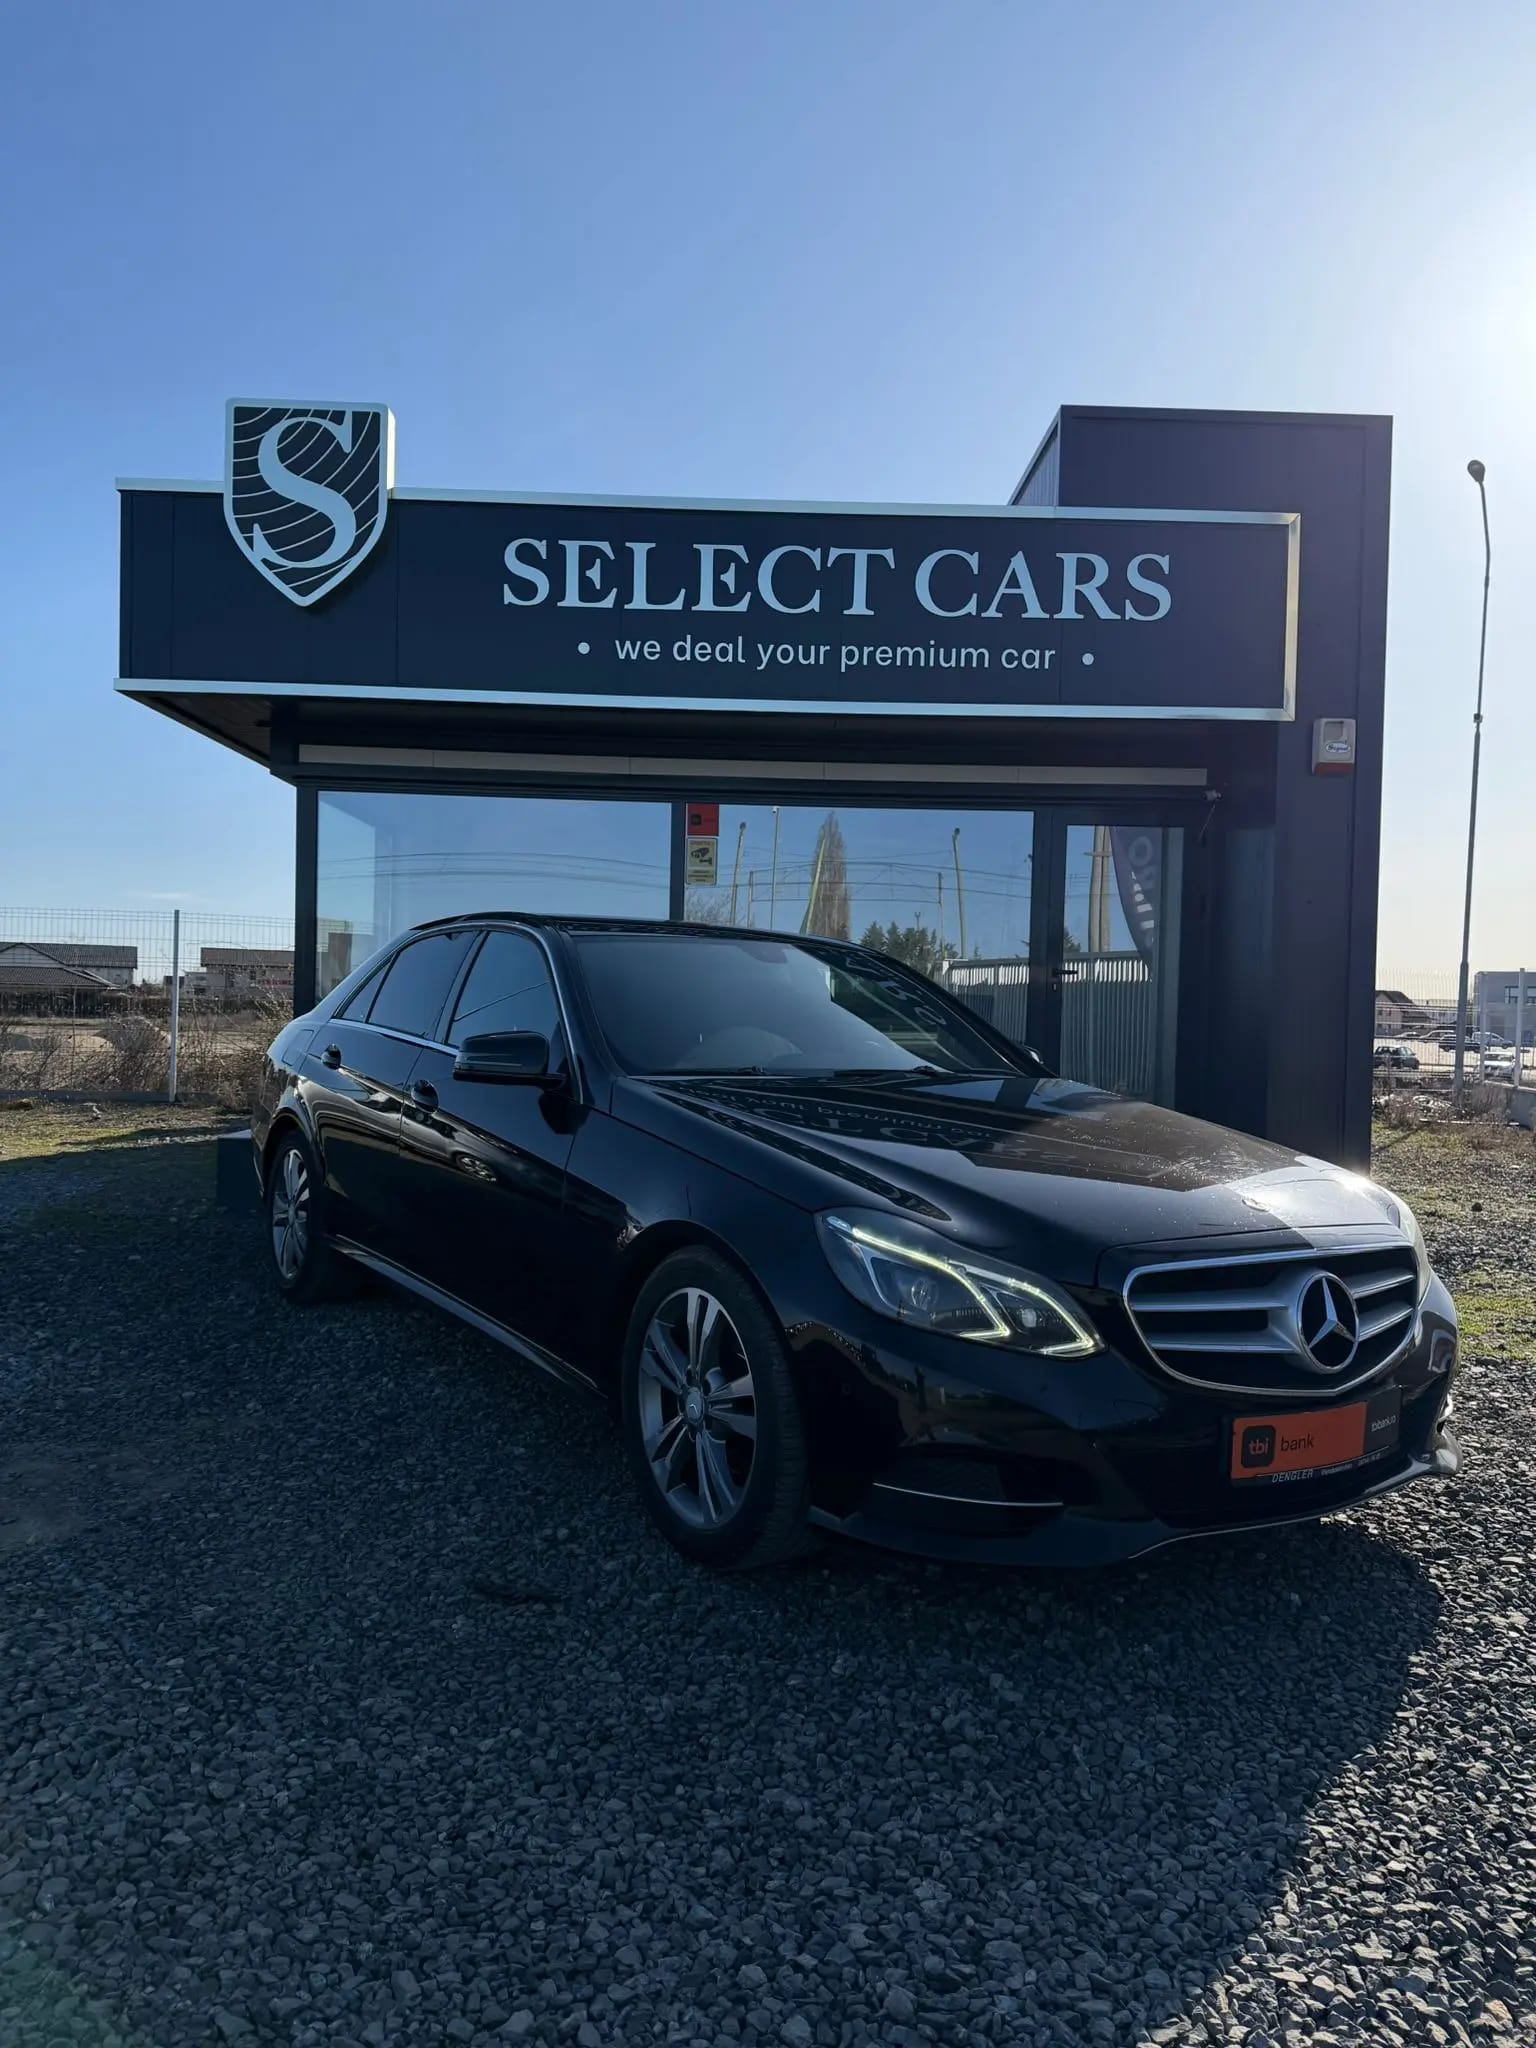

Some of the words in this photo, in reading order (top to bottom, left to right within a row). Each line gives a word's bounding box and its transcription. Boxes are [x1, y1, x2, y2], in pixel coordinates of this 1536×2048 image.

[252, 411, 357, 568] S
[503, 537, 896, 616] SELECT
[914, 548, 1172, 622] CARS
[615, 638, 661, 661] we
[672, 634, 746, 664] deal
[756, 642, 830, 671] your
[840, 639, 990, 673] premium
[1000, 647, 1055, 671] car
[1248, 1437, 1270, 1455] tbi
[1280, 1433, 1315, 1452] bank
[1271, 1468, 1314, 1484] DENGLER
